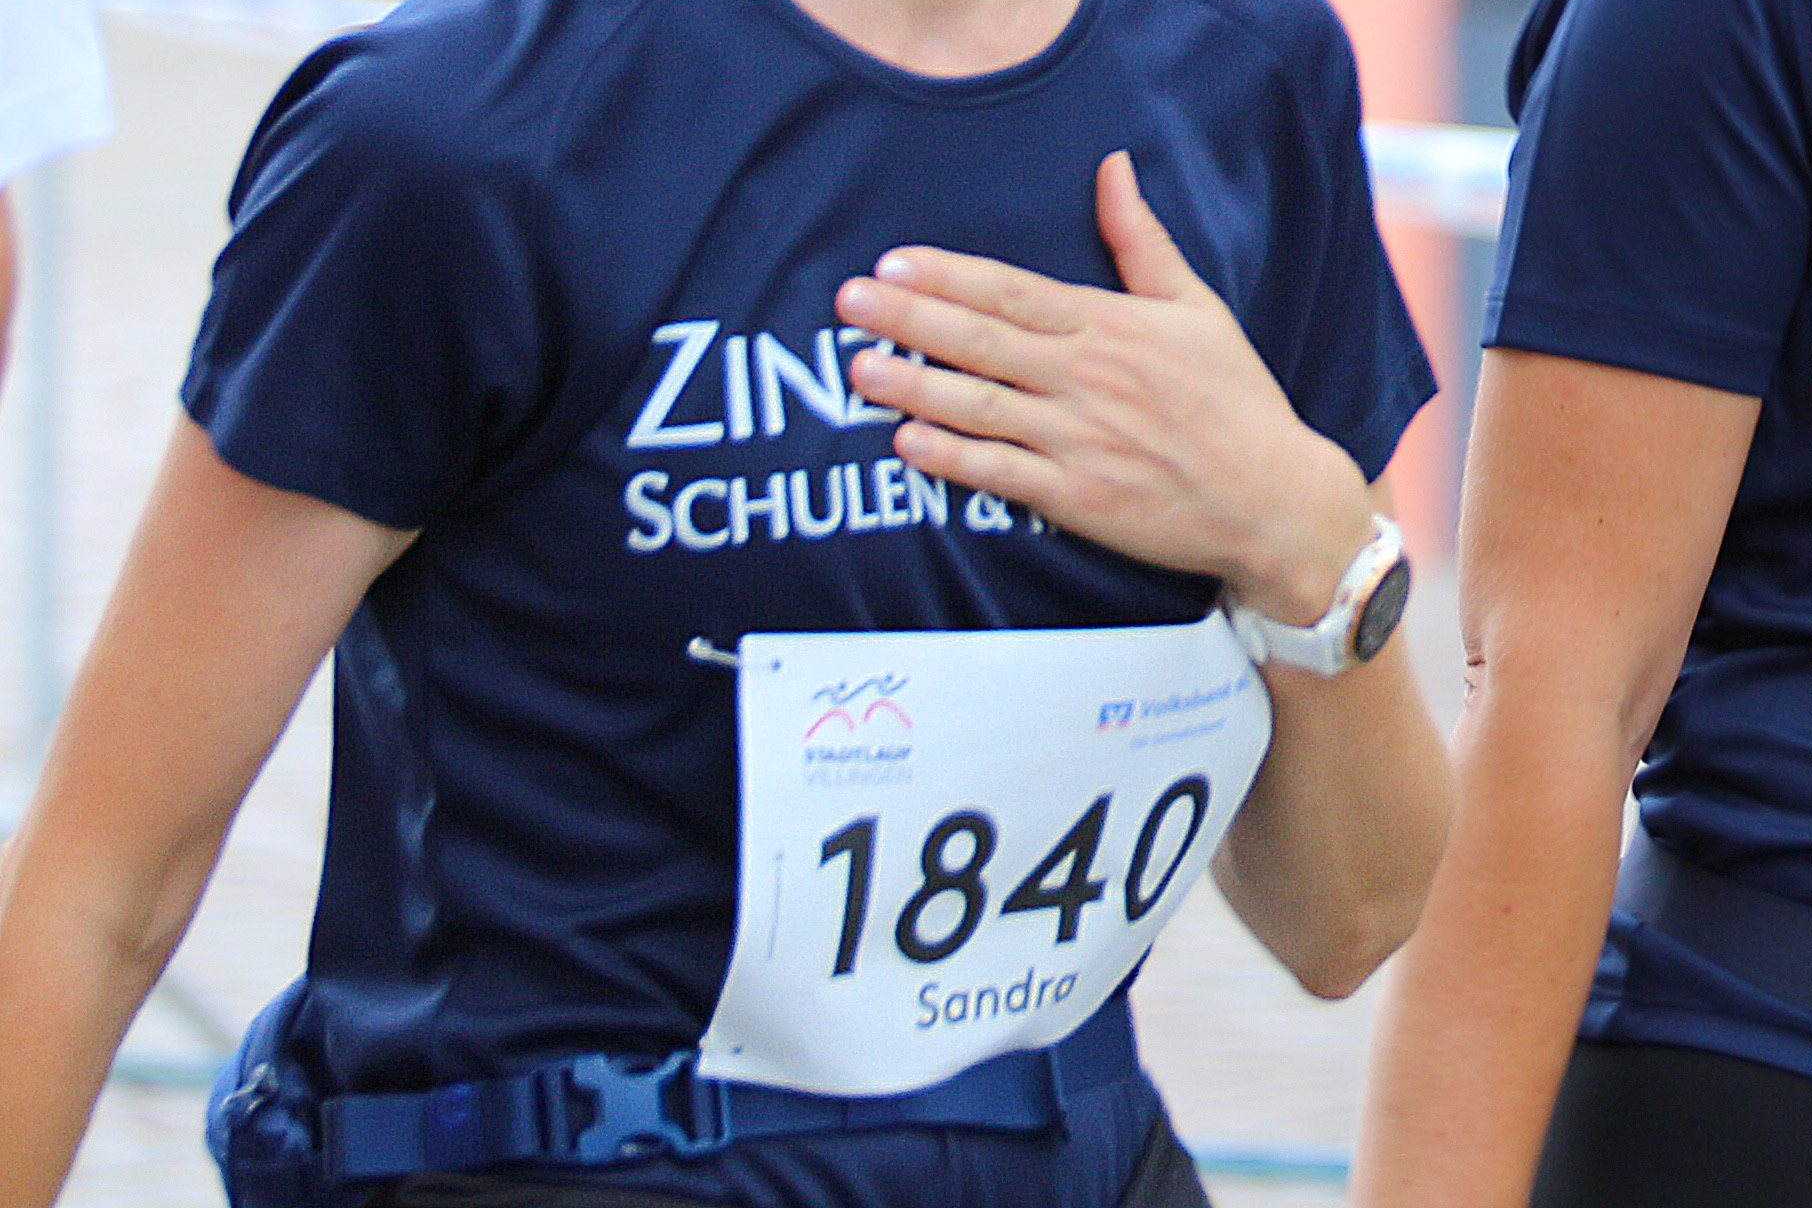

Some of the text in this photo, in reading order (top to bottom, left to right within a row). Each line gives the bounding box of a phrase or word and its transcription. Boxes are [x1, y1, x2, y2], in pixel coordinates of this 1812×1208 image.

[624, 456, 949, 551] SCHULEN
[819, 771, 1213, 978] 1840
[916, 966, 1078, 1030] Sandra
